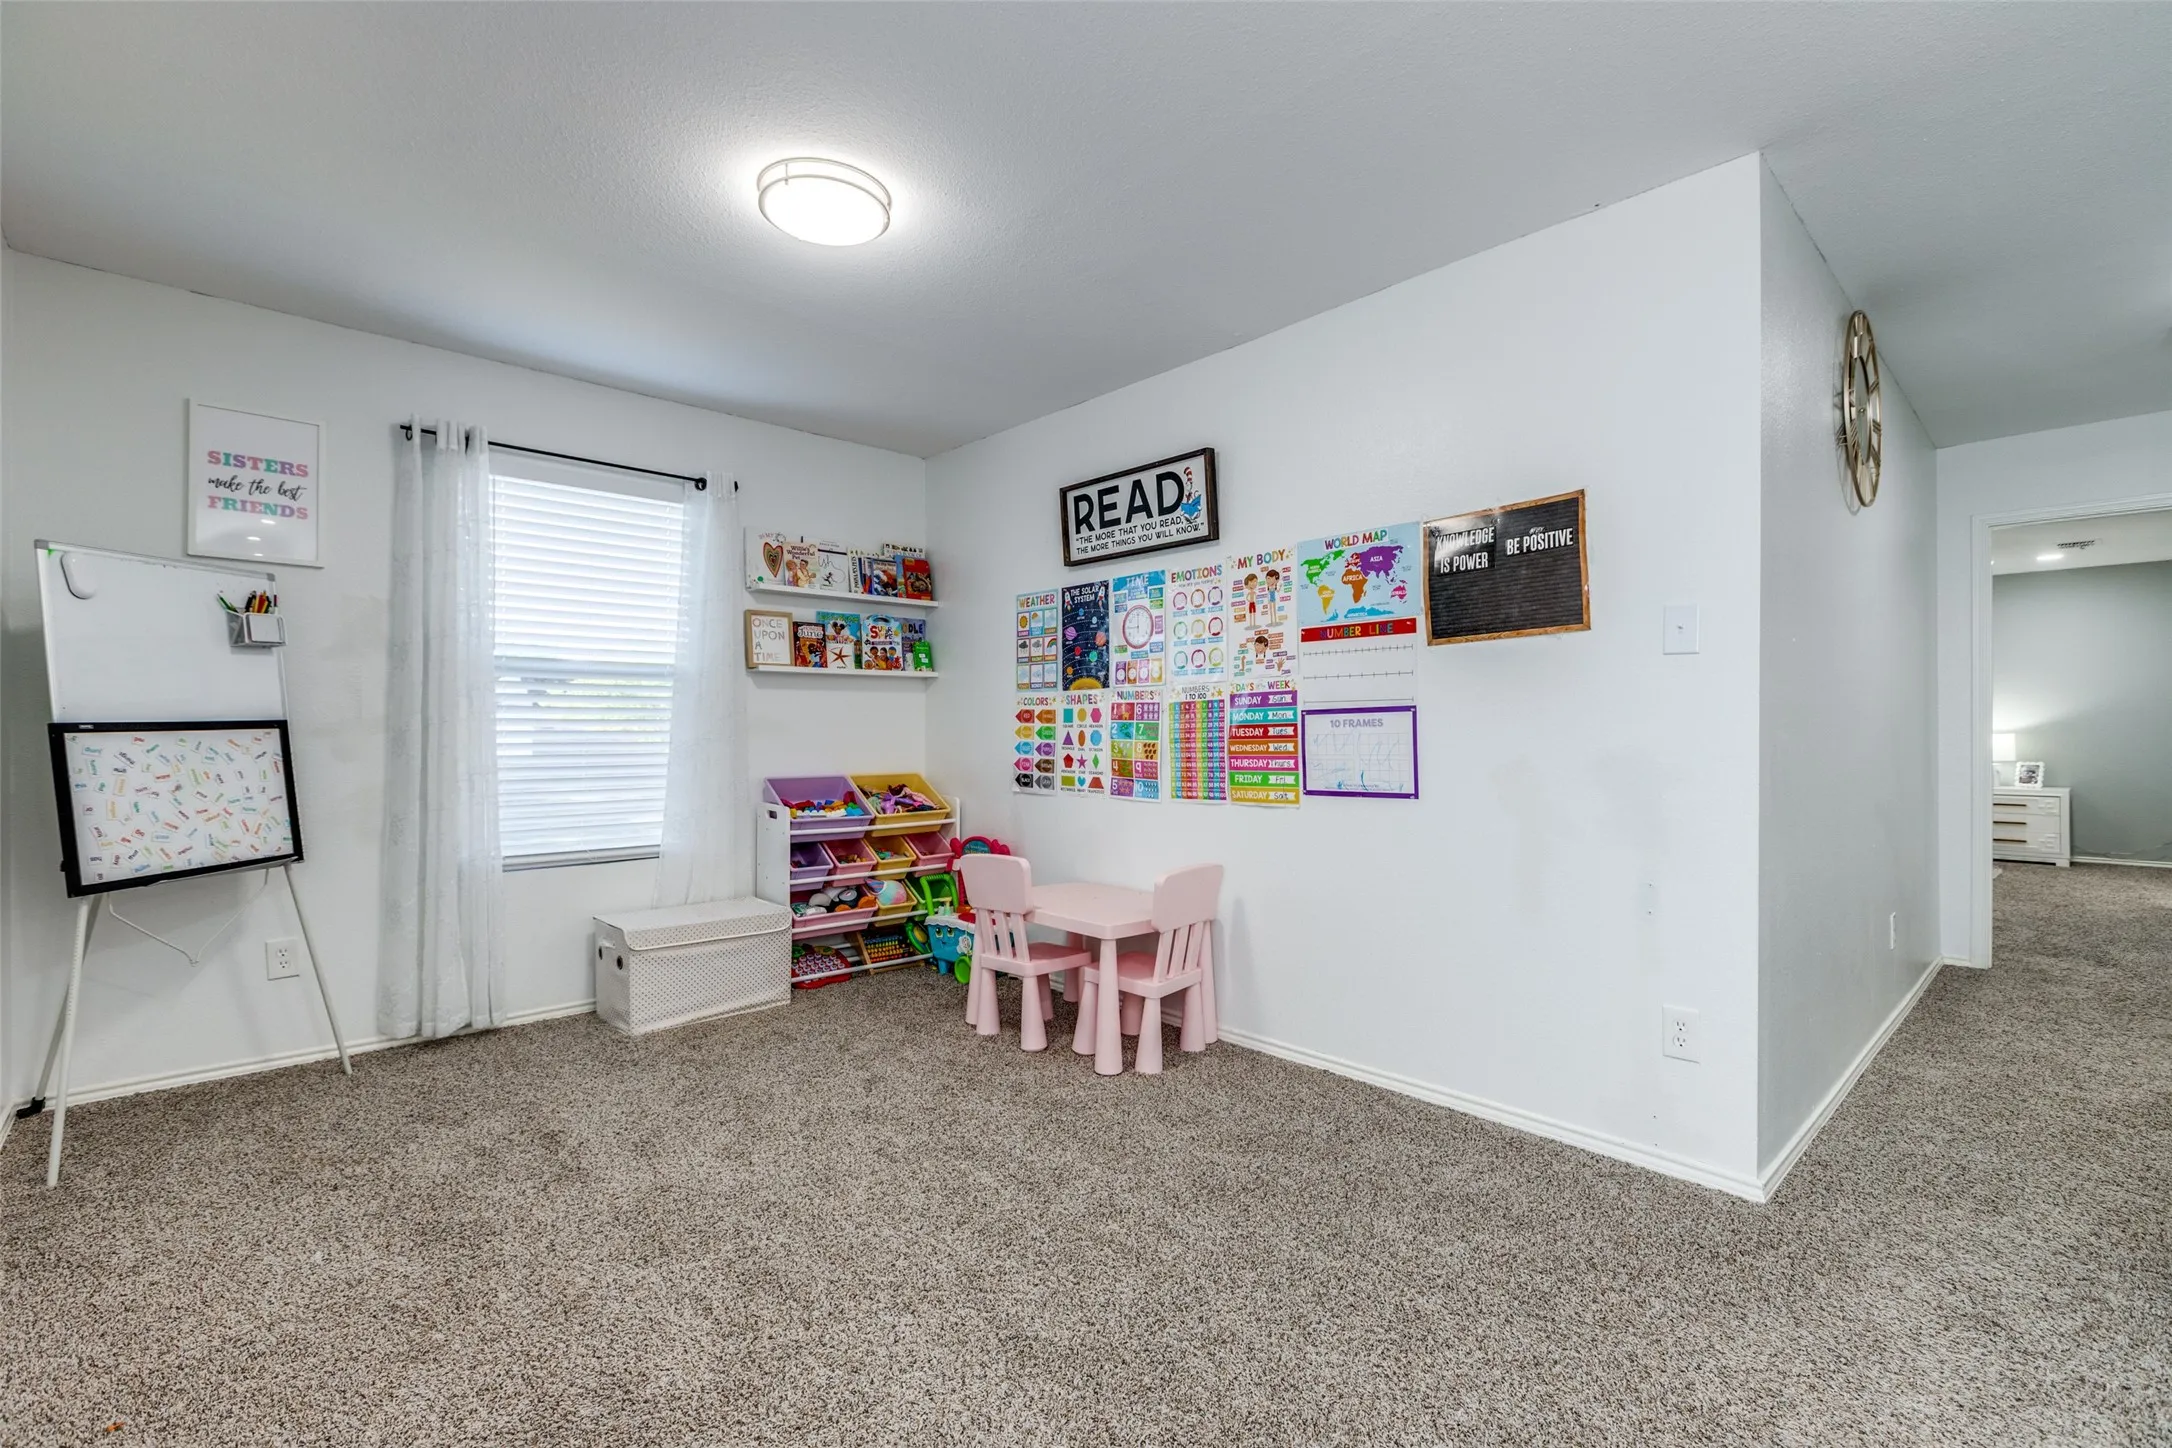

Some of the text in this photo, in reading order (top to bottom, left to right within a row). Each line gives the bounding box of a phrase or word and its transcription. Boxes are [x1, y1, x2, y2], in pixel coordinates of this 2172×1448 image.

[207, 450, 309, 478] SISTERS
[208, 474, 307, 501] make the best
[207, 495, 309, 520] FRIENDS
[1073, 471, 1185, 535] READ
[1095, 531, 1116, 541] MORE
[1120, 525, 1138, 537] THAT
[1141, 522, 1157, 532] YOU
[1160, 516, 1184, 529] READ,
[1077, 547, 1089, 555] THE
[1091, 543, 1109, 552] MORE
[1111, 536, 1136, 549] THINGS
[1138, 534, 1153, 543] YOU
[1156, 530, 1174, 540] WILL
[1325, 530, 1388, 550] WORLD MAP
[1436, 527, 1495, 551] KNOWLEDGE
[1506, 538, 1520, 555] BE
[1523, 528, 1574, 553] POSITIVE
[786, 549, 815, 557] Wonderful
[1237, 549, 1285, 569] MY BODY
[1440, 552, 1488, 574] IS POWER
[1171, 564, 1222, 583] EMOTIONS
[1126, 575, 1149, 587] TIME
[1070, 585, 1099, 597] THE SOLAR
[1018, 594, 1056, 608] WEATHER
[1074, 594, 1095, 604] SYSTEM
[753, 618, 783, 628] ONCE
[754, 631, 785, 640] UPON
[798, 627, 823, 638] June
[1320, 623, 1394, 638] NUMBER LINE
[755, 641, 762, 650] A
[754, 652, 780, 661] TIME
[1181, 685, 1210, 694] NUMBERS
[1235, 683, 1254, 692] DAYS
[1268, 680, 1290, 690] WEEK
[1066, 694, 1098, 705] SHAPES
[1117, 691, 1155, 700] NUMBERS
[1234, 696, 1262, 706] SUNDAY
[1023, 697, 1048, 706] COLORS
[1113, 704, 1117, 715] 1
[1136, 704, 1142, 715] 6
[1233, 712, 1264, 721] MONDAY
[1112, 723, 1118, 734] 2
[1330, 718, 1384, 728] 10 FRAMES
[1138, 723, 1145, 735] 7
[1232, 728, 1264, 737] TUESDAY
[1113, 742, 1118, 753] 3
[1137, 742, 1142, 753] 8
[1112, 760, 1118, 771] 4
[1135, 762, 1142, 773] 9
[1231, 759, 1268, 767] THURSDAY
[1234, 774, 1263, 783] FRIDAY
[1112, 779, 1118, 790] 5
[1135, 781, 1144, 792] 10
[1232, 791, 1268, 799] SATURDAY
